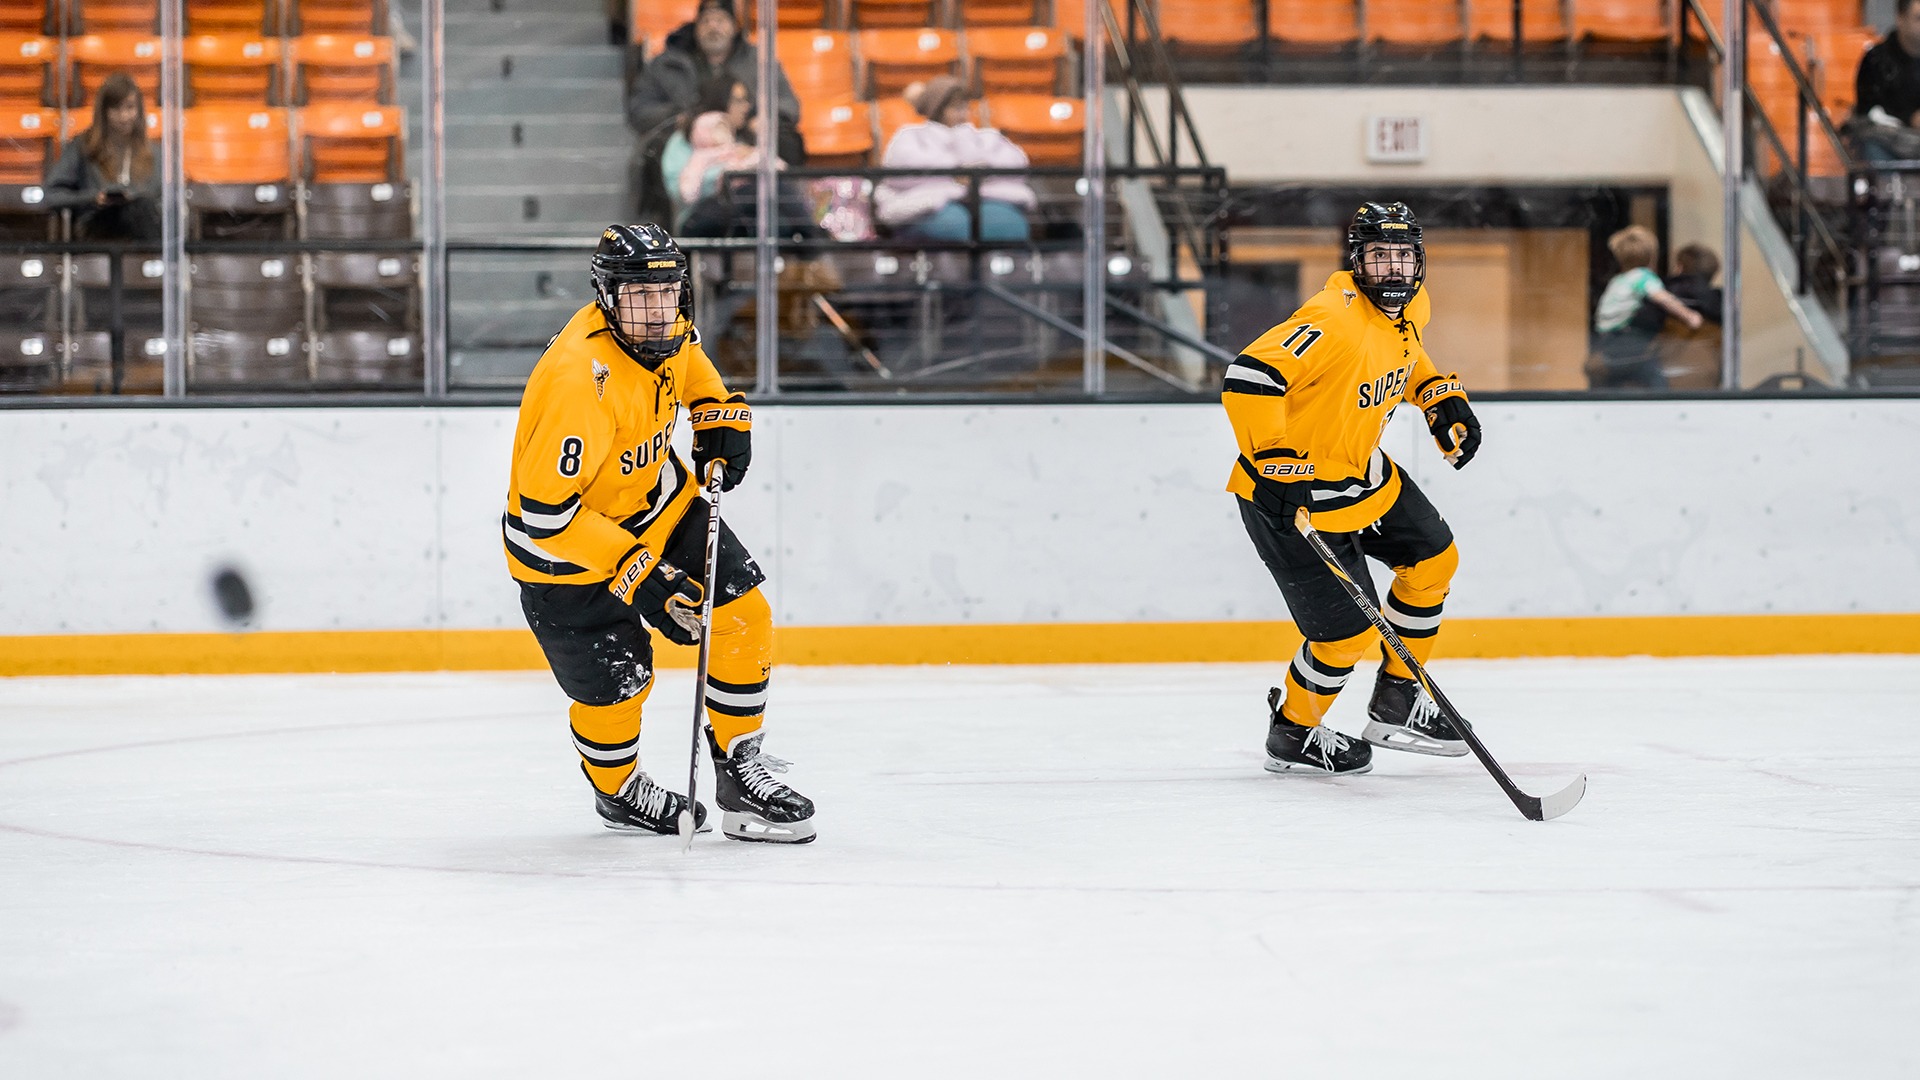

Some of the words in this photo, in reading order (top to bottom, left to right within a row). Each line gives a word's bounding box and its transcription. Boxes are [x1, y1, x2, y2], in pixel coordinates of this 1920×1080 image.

[1377, 118, 1420, 152] EXIT
[647, 260, 677, 269] SUPERIOR
[1280, 323, 1324, 360] 11
[1421, 381, 1465, 405] BAU
[691, 408, 752, 425] BAUE
[618, 402, 680, 476] SUPE
[557, 435, 584, 478] 8
